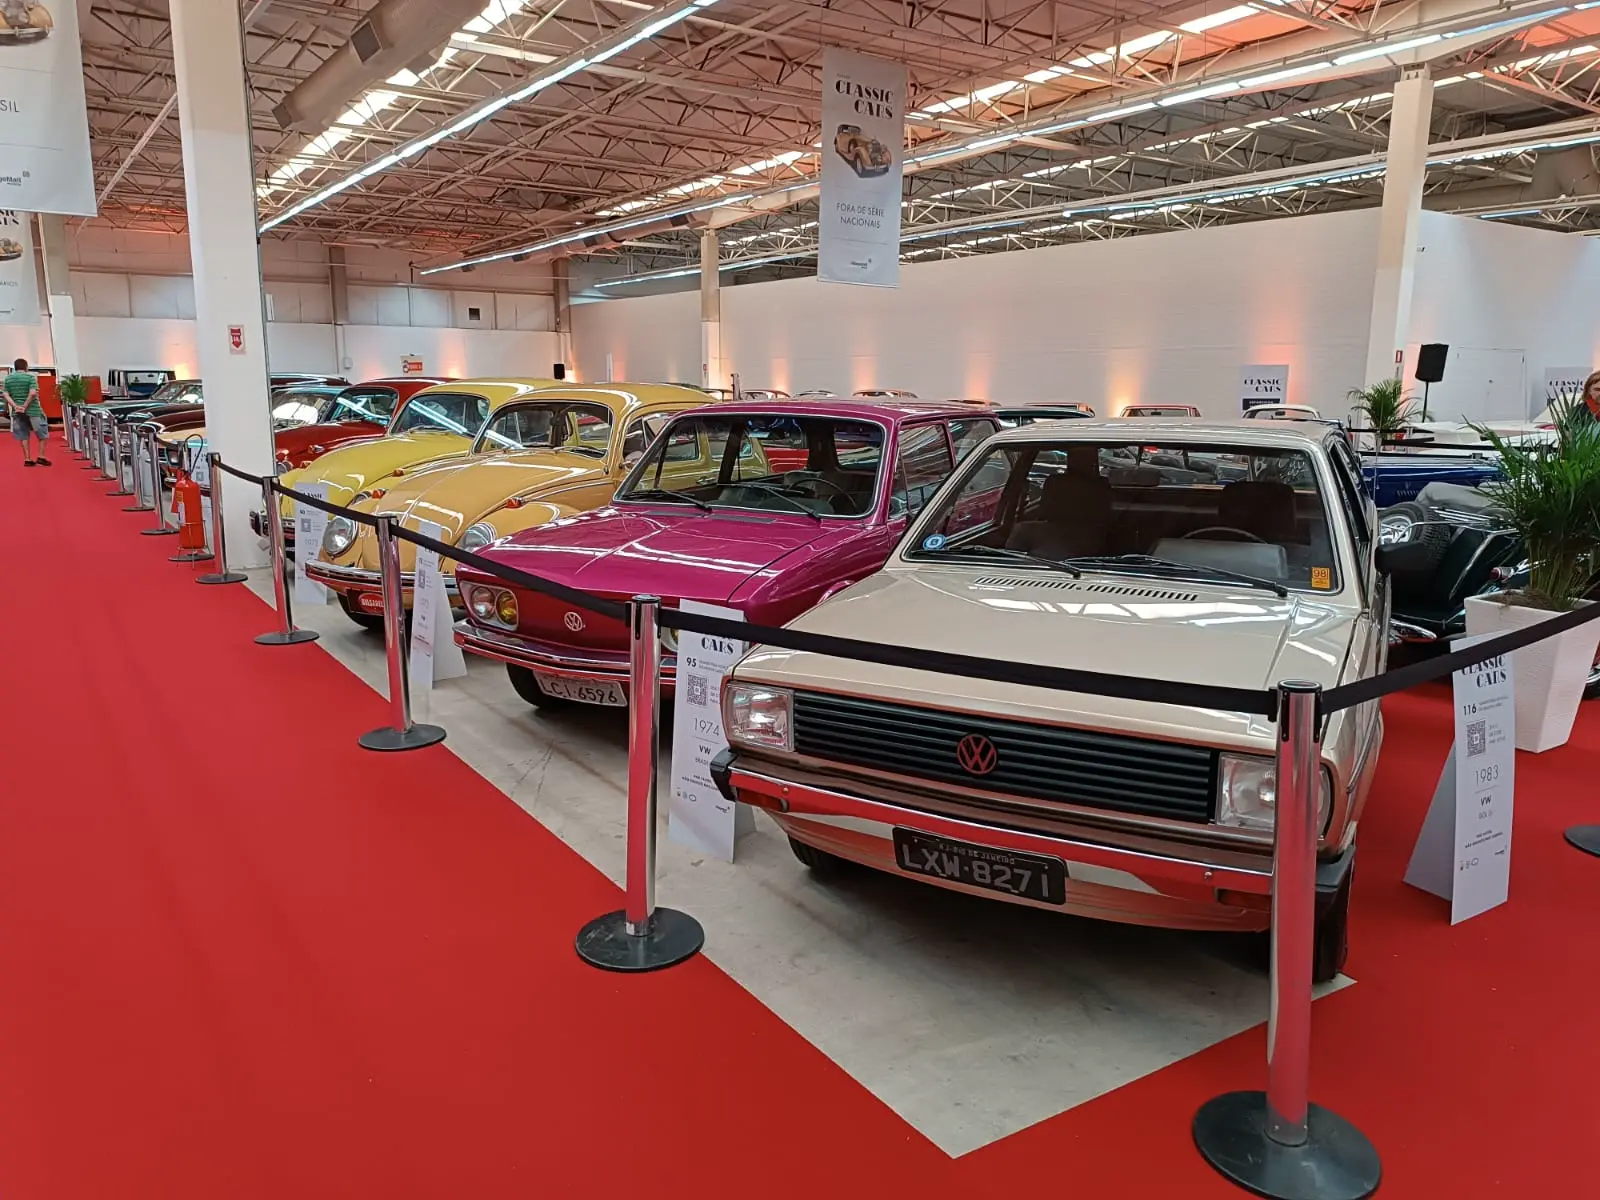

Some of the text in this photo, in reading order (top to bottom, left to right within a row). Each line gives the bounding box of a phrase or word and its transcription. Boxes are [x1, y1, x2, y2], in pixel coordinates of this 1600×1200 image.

[835, 79, 894, 104] CLASSIC
[854, 98, 893, 119] CARS
[837, 202, 856, 213] FORA
[857, 206, 866, 215] DE
[841, 216, 881, 229] NACIONAIS
[1243, 378, 1281, 386] CLASSIC
[1313, 569, 1327, 578] 98
[701, 637, 734, 655] CARS
[686, 657, 697, 668] 95
[1476, 669, 1507, 688] CARS
[1463, 703, 1477, 716] 116
[694, 717, 720, 737] 1974
[699, 744, 712, 756] VW
[957, 734, 997, 774] VW
[1475, 764, 1499, 786] 1983
[1480, 795, 1492, 807] VW
